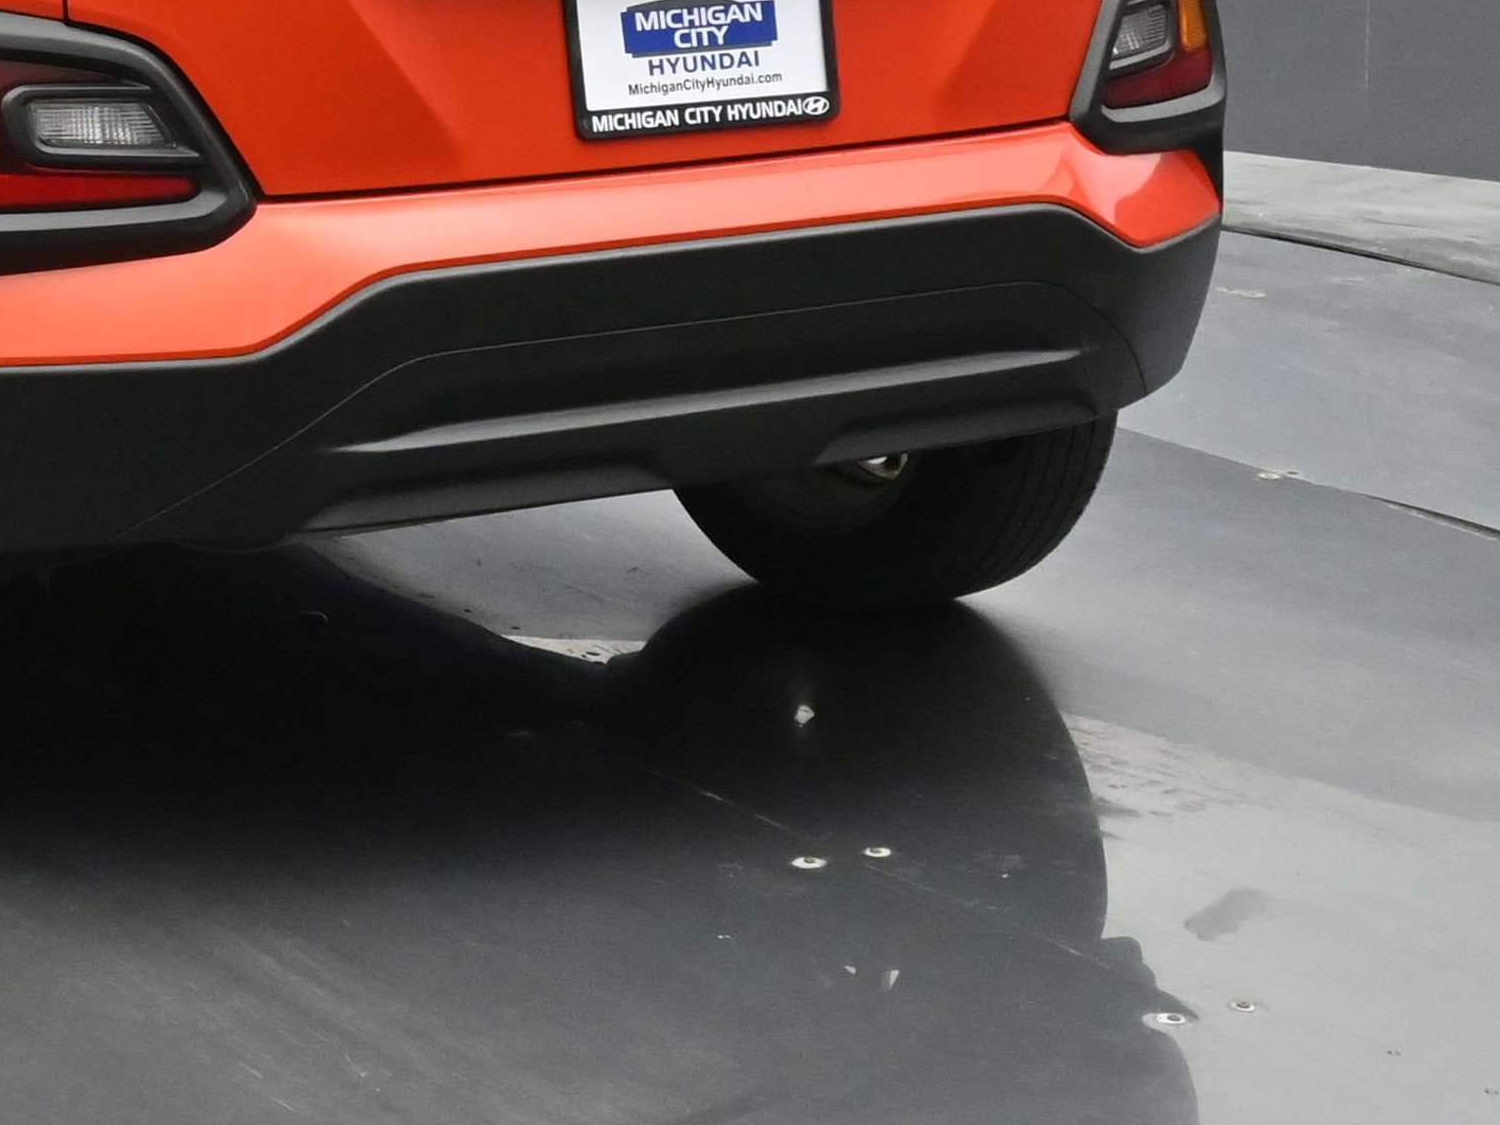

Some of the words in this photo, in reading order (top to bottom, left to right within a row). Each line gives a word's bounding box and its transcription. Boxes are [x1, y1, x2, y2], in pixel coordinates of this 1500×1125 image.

[634, 2, 763, 32] MICHIGAN
[674, 26, 730, 49] CITY
[648, 50, 760, 76] HYUNDAI
[628, 72, 783, 96] MichiganCityHyundai.com
[592, 109, 679, 133] MICHIGAN
[684, 106, 723, 124] CITY
[727, 98, 803, 121] HYUNDAI
